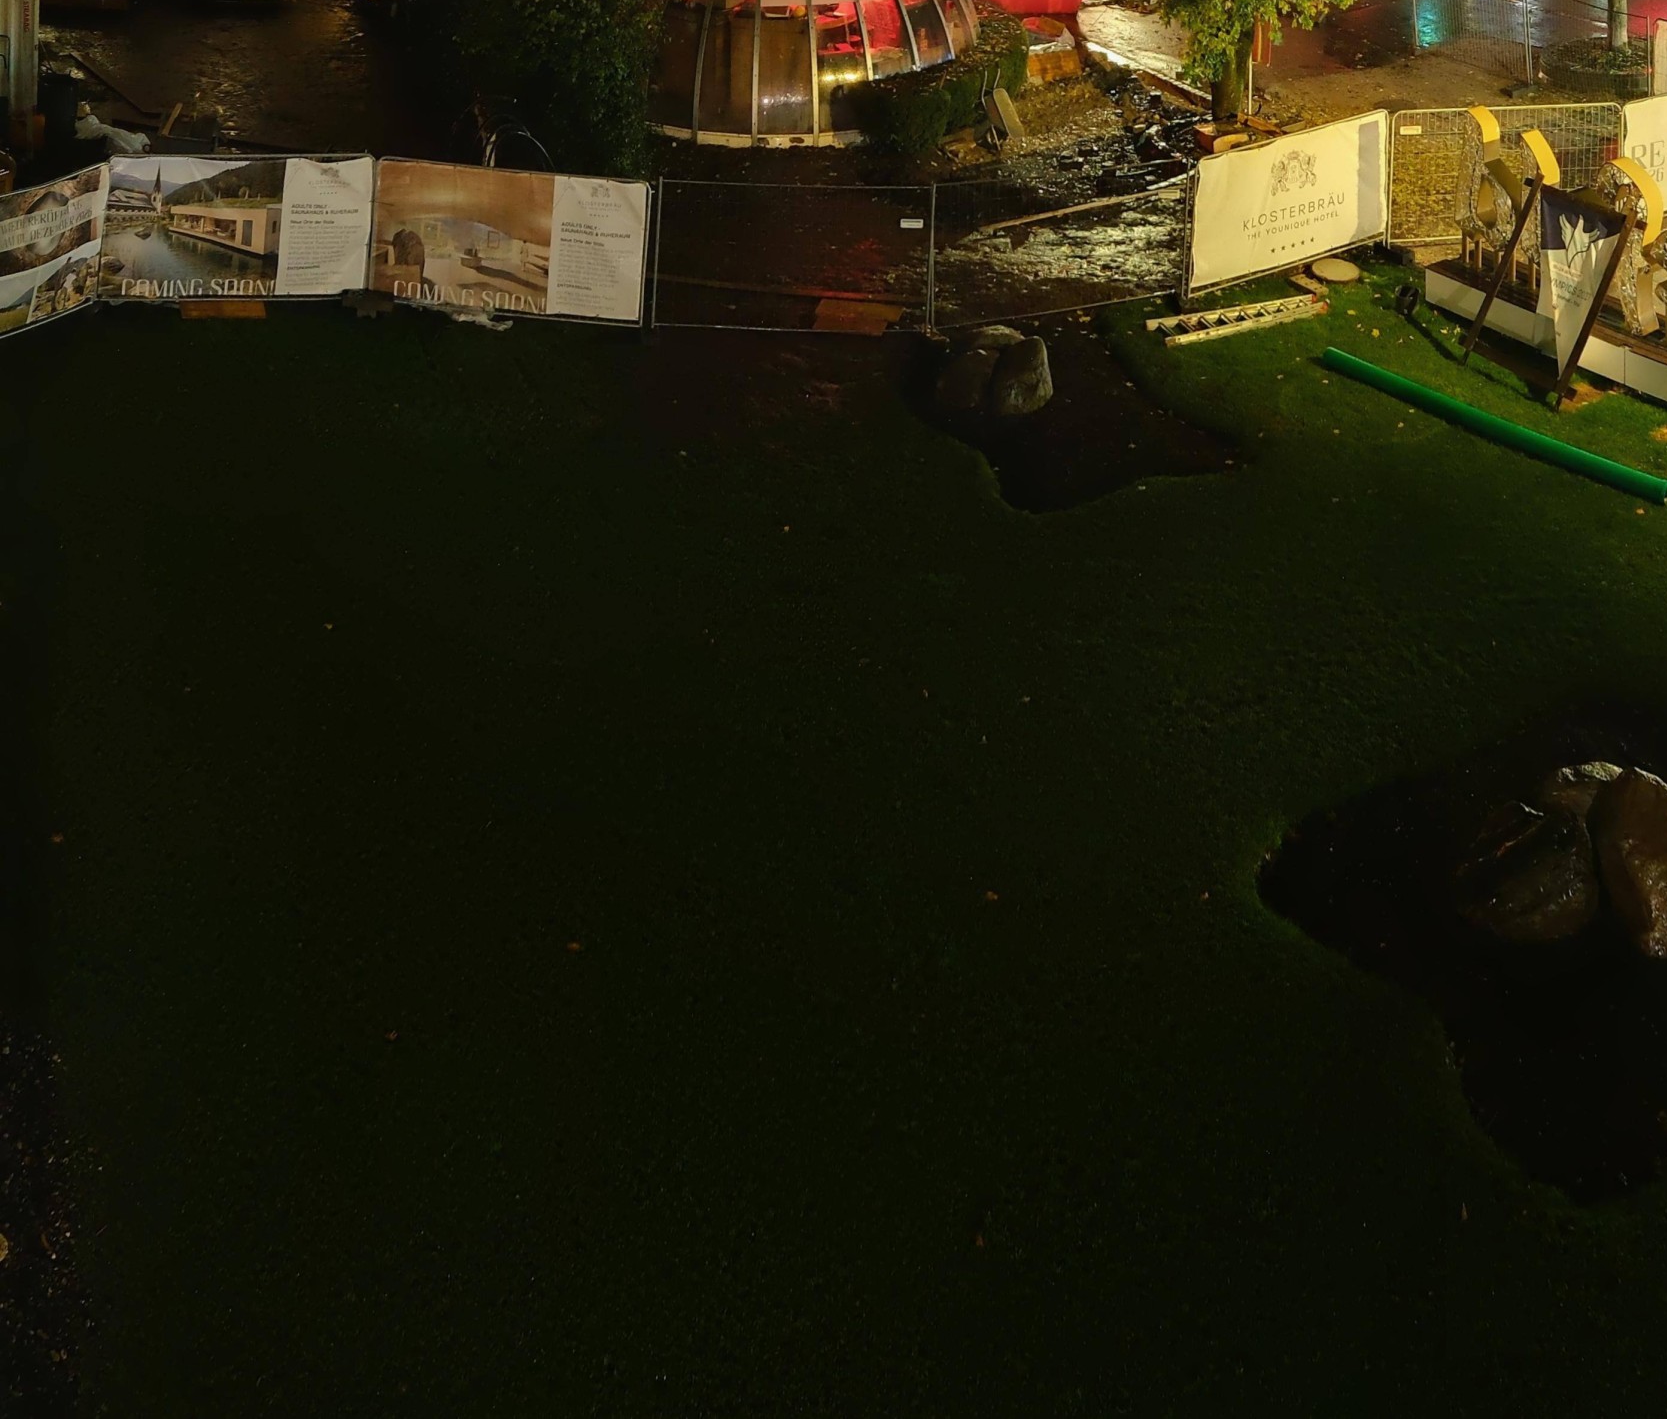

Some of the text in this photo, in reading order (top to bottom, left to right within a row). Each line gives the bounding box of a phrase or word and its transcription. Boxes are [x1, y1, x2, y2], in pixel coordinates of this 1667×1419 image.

[1242, 192, 1345, 232] KLOSTERBRÄU
[1247, 210, 1340, 241] THE YOUNIQUE HOTEL
[121, 278, 203, 296] COMING
[210, 278, 276, 296] SOON!
[393, 279, 475, 307] COMING
[481, 290, 547, 314] SOON!
